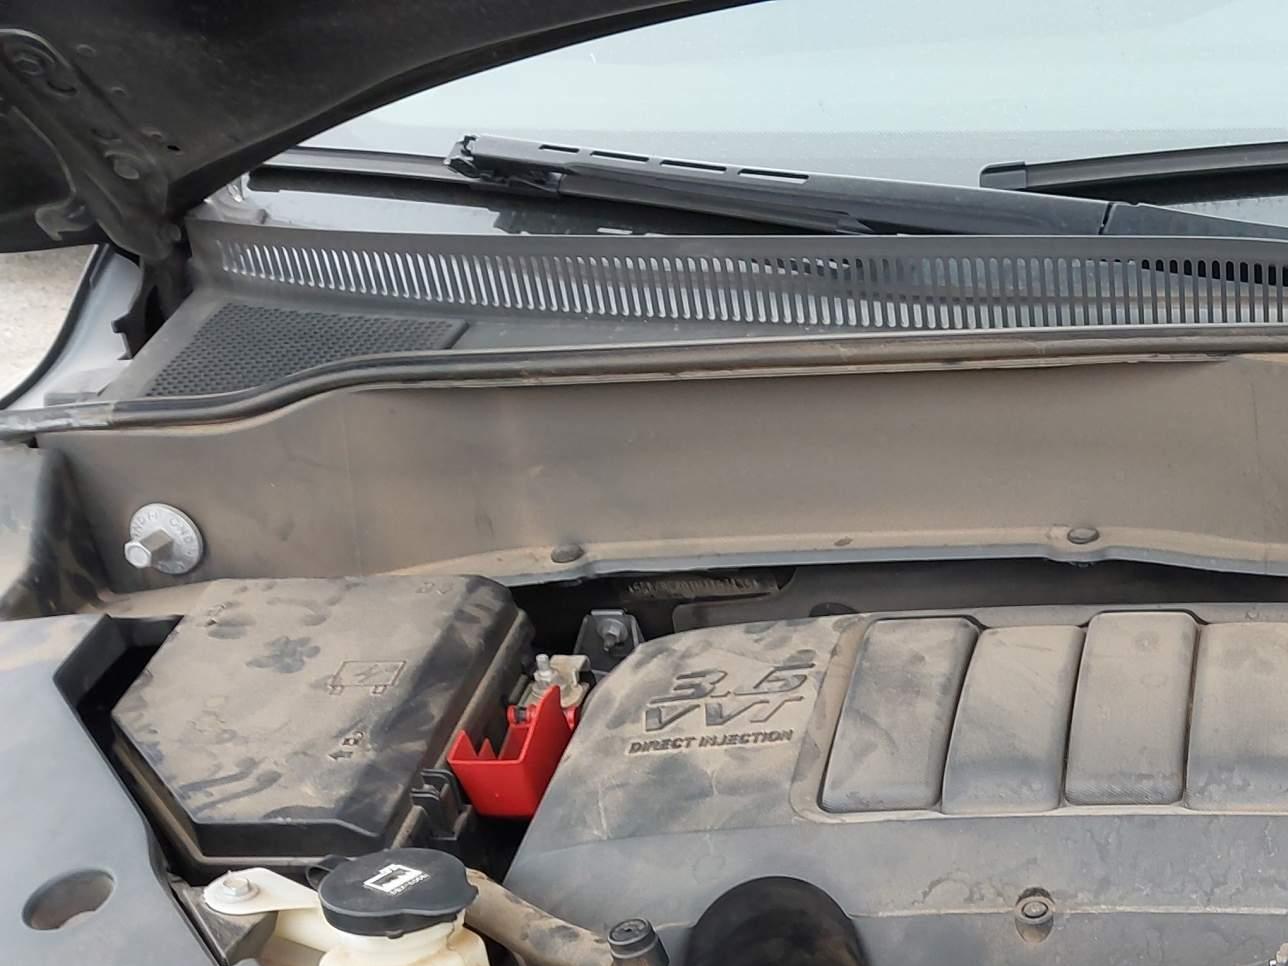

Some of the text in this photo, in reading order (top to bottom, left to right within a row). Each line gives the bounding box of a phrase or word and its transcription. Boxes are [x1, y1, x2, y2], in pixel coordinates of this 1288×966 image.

[648, 662, 816, 706] 3.6
[627, 729, 793, 754] DIRECT INJECTION
